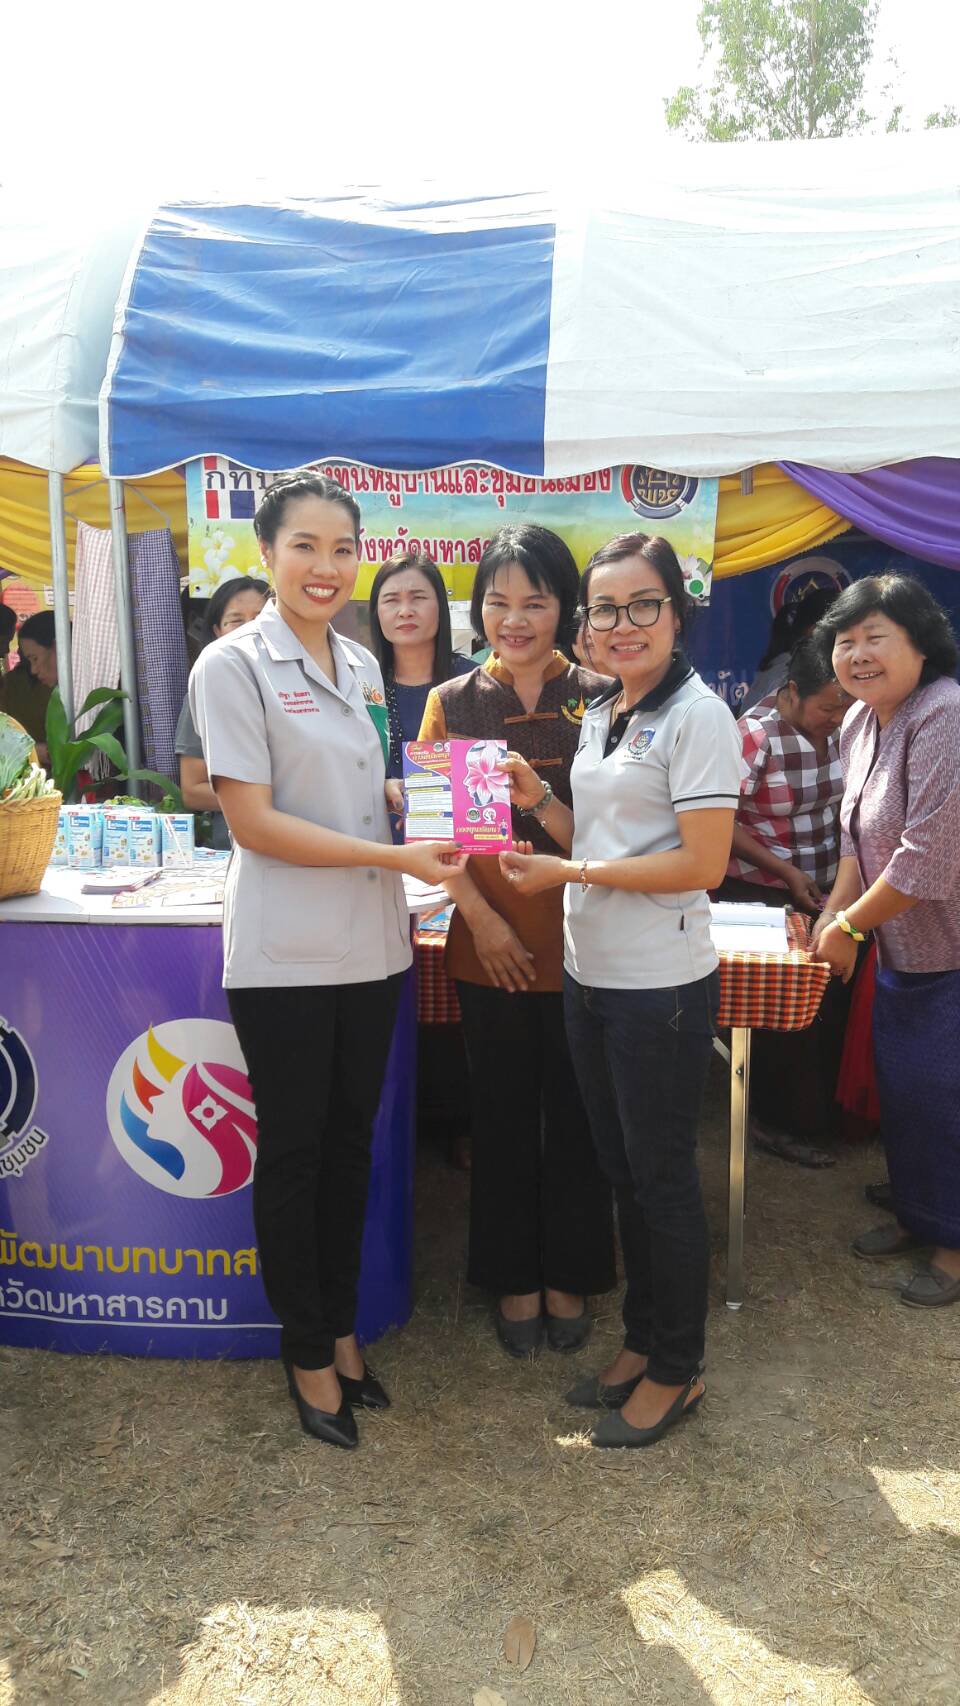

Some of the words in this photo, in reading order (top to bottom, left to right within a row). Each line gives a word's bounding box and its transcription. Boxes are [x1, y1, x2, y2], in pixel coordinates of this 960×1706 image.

[0, 1129, 46, 1176] ชุมชน
[0, 1278, 228, 1321] วัดมหาสารคาม
